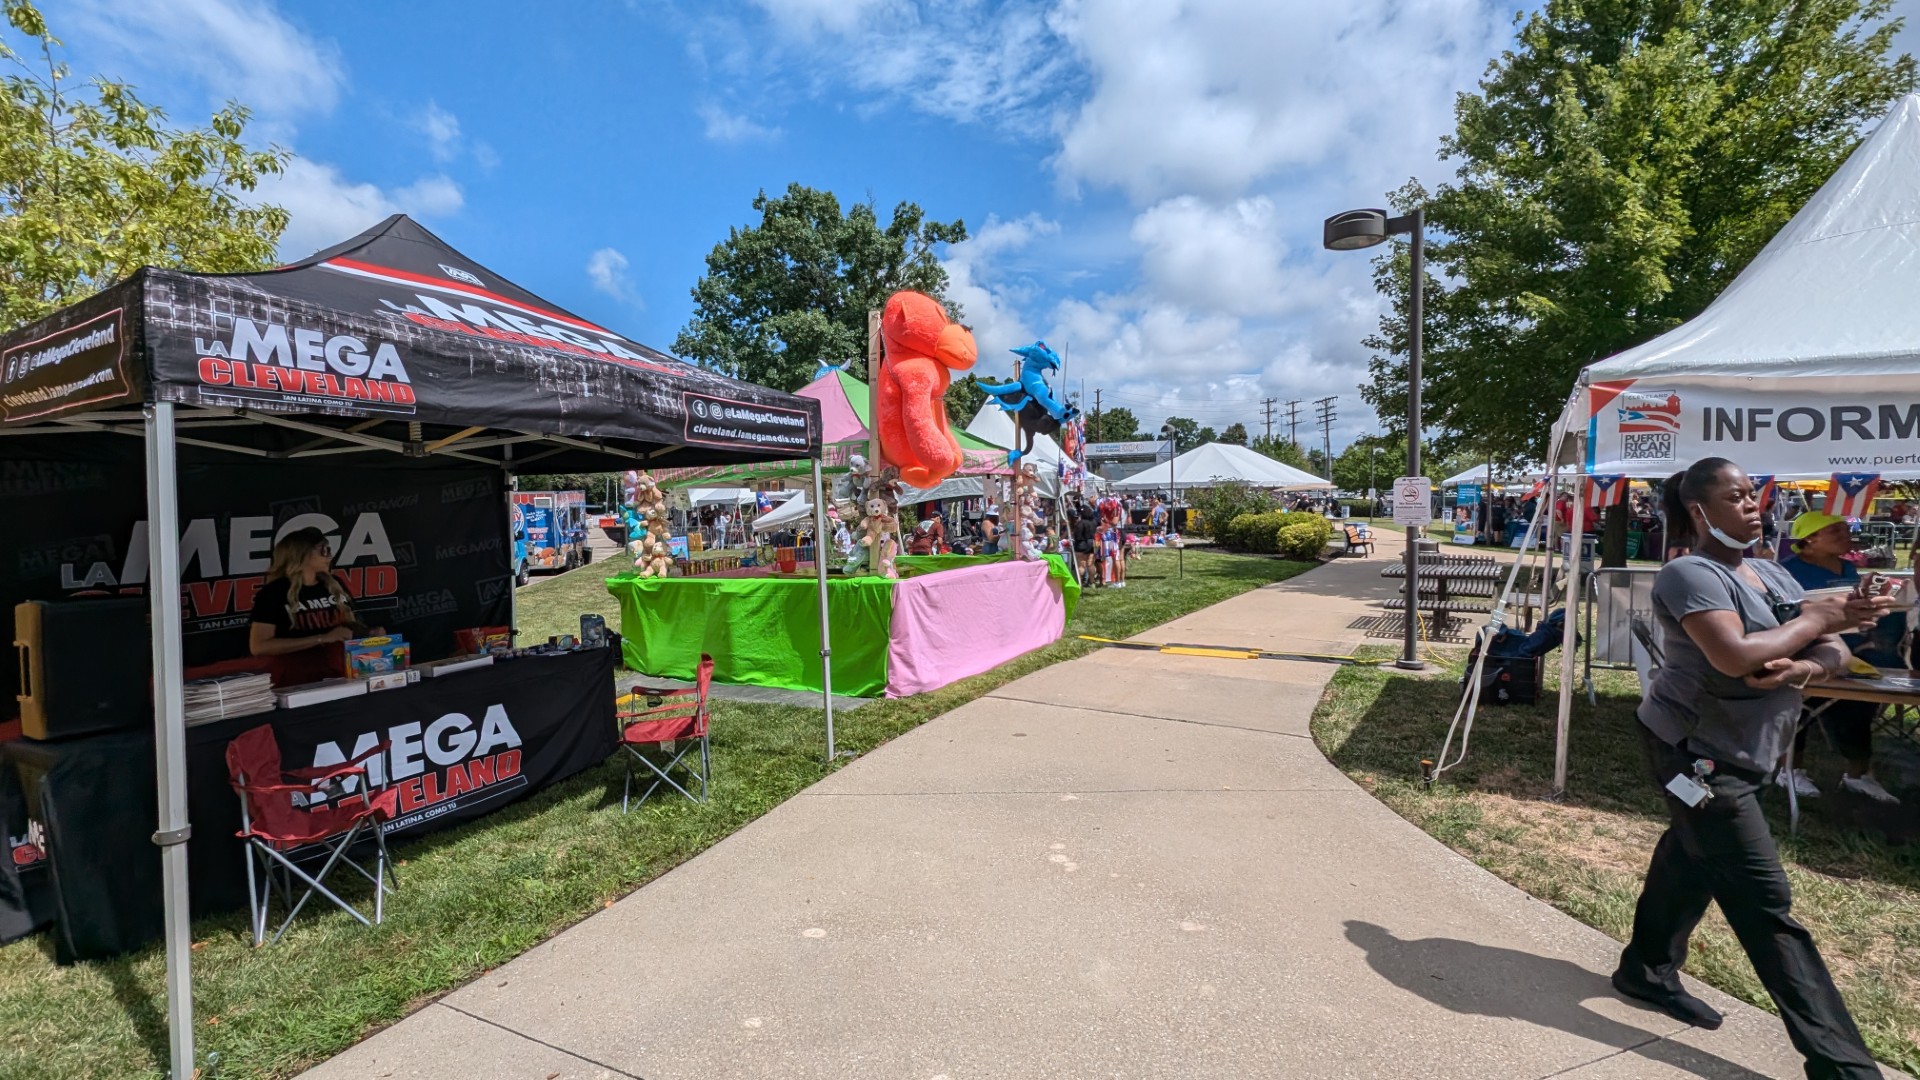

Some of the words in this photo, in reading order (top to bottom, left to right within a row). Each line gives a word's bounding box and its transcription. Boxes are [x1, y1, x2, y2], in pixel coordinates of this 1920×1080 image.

[415, 294, 659, 364] MEGA
[195, 337, 231, 358] LA
[230, 317, 411, 384] MEGA
[198, 357, 416, 405] CLEVELAND
[282, 394, 297, 402] TAN
[298, 396, 322, 404] LATINA
[724, 407, 805, 427] @LaMegaCleveland
[1703, 404, 1920, 442] INFORM
[693, 424, 806, 445] cleveland.lamegamedia.com
[1625, 433, 1671, 443] PUERTO
[1624, 441, 1671, 452] RICAN
[1624, 450, 1671, 459] PARADE
[1828, 453, 1920, 467] www.puert
[61, 561, 118, 590] LA
[119, 512, 396, 585] MEGA
[198, 619, 220, 630] TAN
[310, 703, 522, 804] MEGA
[383, 824, 394, 832] AN
[395, 814, 424, 828] LATINA
[424, 806, 447, 818] COMO
